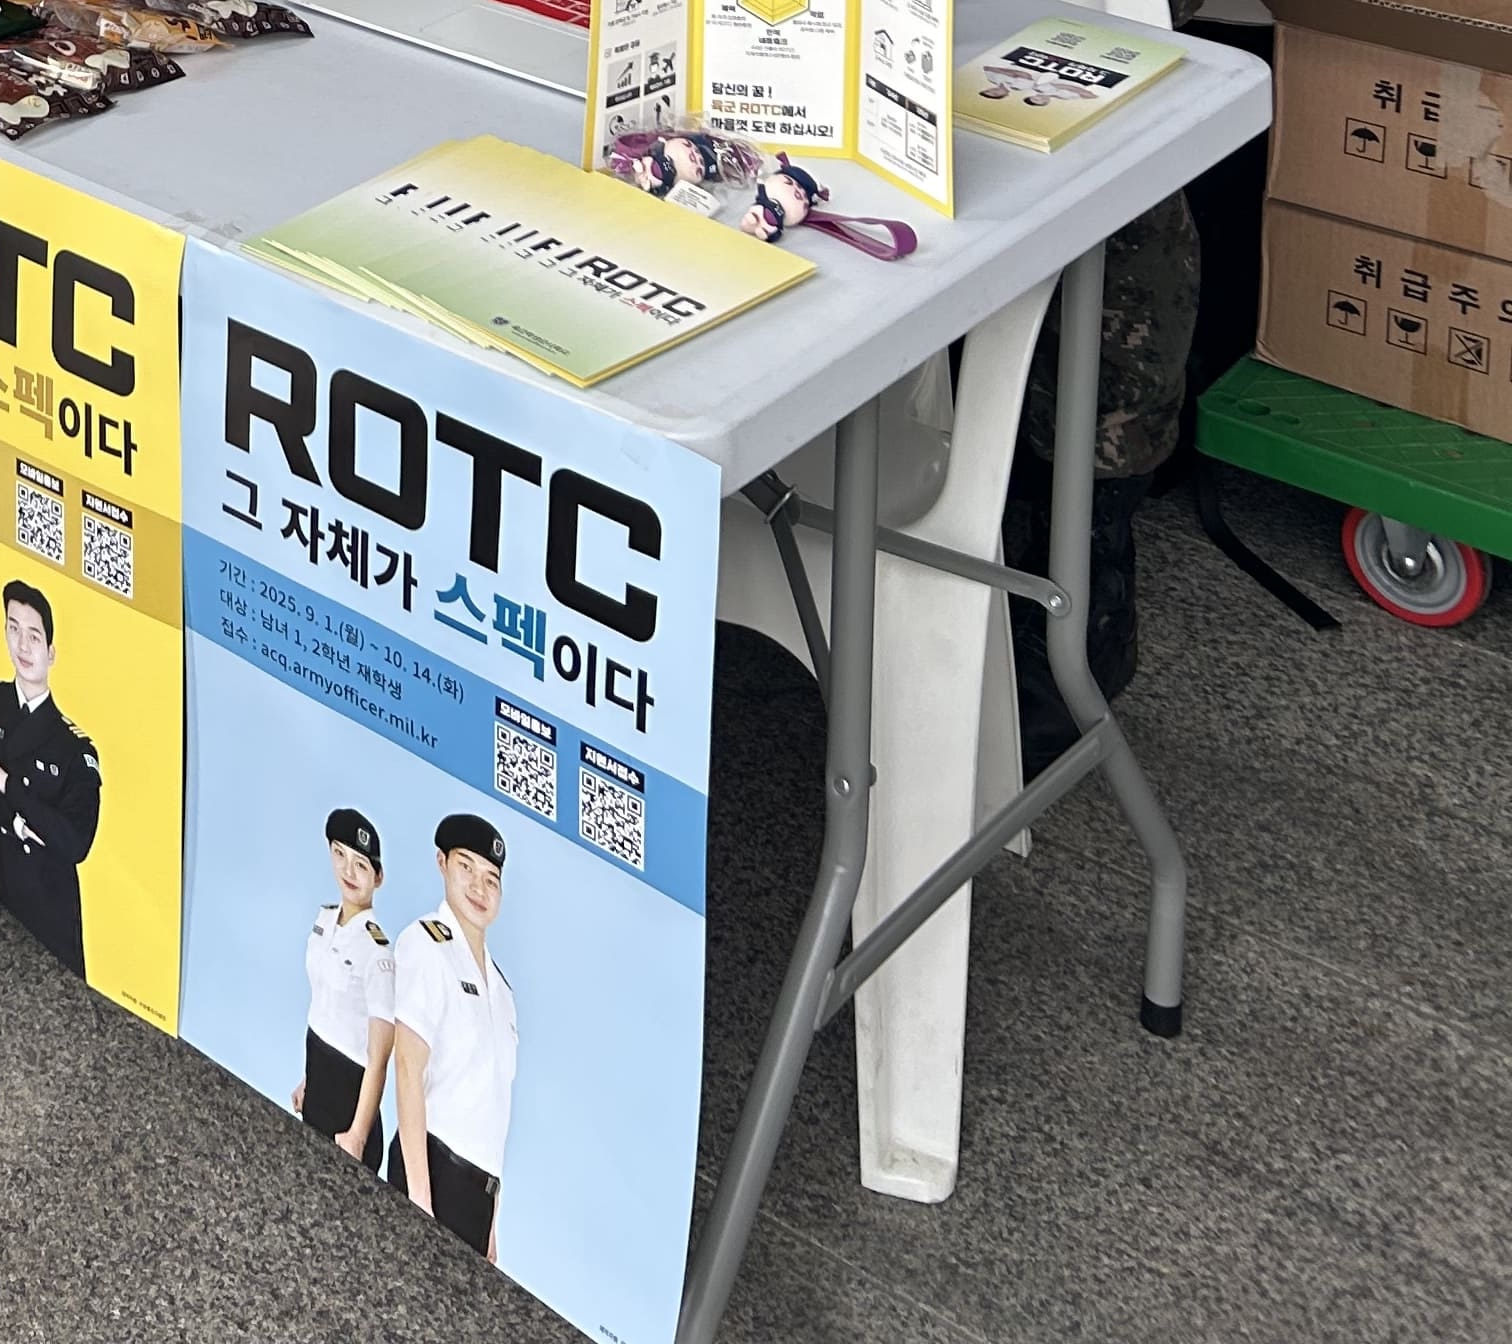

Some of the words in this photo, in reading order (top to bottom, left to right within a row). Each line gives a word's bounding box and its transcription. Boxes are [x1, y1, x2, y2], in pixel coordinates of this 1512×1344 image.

[712, 82, 748, 96] 당신의
[739, 102, 806, 118] ROTC에서
[751, 120, 776, 134] 도전
[574, 255, 707, 318] ROTC
[224, 316, 663, 644] ROTC
[219, 559, 247, 588] 기간
[260, 581, 301, 617] 2025.
[305, 607, 320, 626] 9.
[324, 615, 366, 651] 1.(월)
[384, 646, 407, 673] 10.
[413, 661, 464, 705] 14.(화)
[220, 589, 248, 616] 대상
[260, 609, 289, 640] 남녀
[294, 629, 308, 653] 1,
[312, 639, 351, 671] 2학년
[357, 662, 403, 701] 재학생
[221, 468, 263, 531] 그
[280, 498, 418, 613] 자체가
[433, 571, 656, 736] 스펙이다
[220, 616, 249, 645] 접수
[261, 643, 439, 749] acq.armyofficer.mil.kr
[584, 745, 641, 788] 지원서접수
